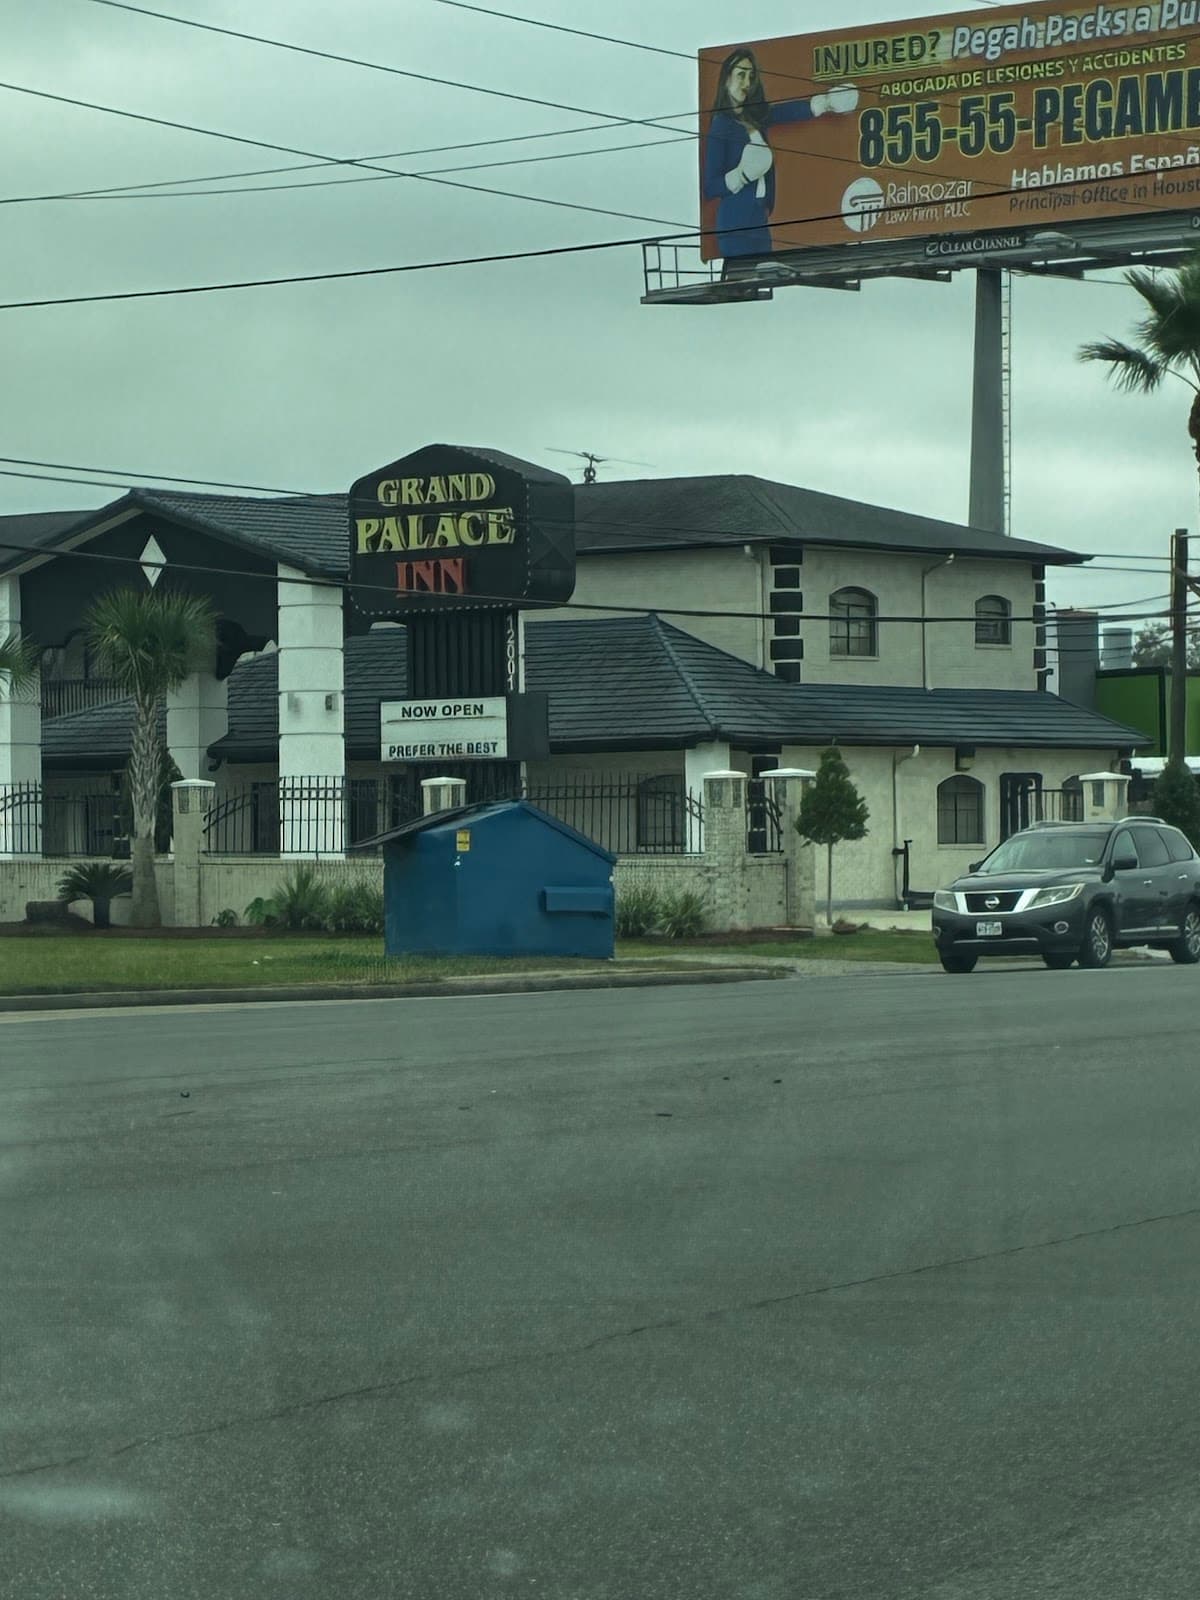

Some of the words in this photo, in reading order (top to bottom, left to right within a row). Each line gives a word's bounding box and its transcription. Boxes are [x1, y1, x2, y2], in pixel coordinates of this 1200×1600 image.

[812, 31, 941, 75] INJURED?
[952, 16, 1036, 61] Pegah
[1046, 5, 1127, 46] Packs
[1134, 5, 1151, 32] a
[1159, 0, 1200, 30] Pu
[880, 73, 957, 97] ABOGADA
[961, 70, 983, 88] DE
[986, 60, 1065, 84] LESIONES
[1068, 58, 1079, 74] Y
[1082, 43, 1187, 72] ACCIDENTES
[1011, 162, 1124, 191] Hablamos
[1010, 189, 1077, 212] Principal
[1081, 184, 1128, 204] Office
[1133, 182, 1148, 199] in
[377, 472, 496, 507] GRAND
[355, 507, 515, 554] PALACE
[395, 558, 467, 597] INN
[506, 614, 516, 691] 12001
[401, 705, 437, 719] NOW
[441, 703, 484, 717] OPEN
[388, 744, 436, 758] PREFER
[439, 743, 463, 756] THE
[466, 741, 498, 754] BEST
